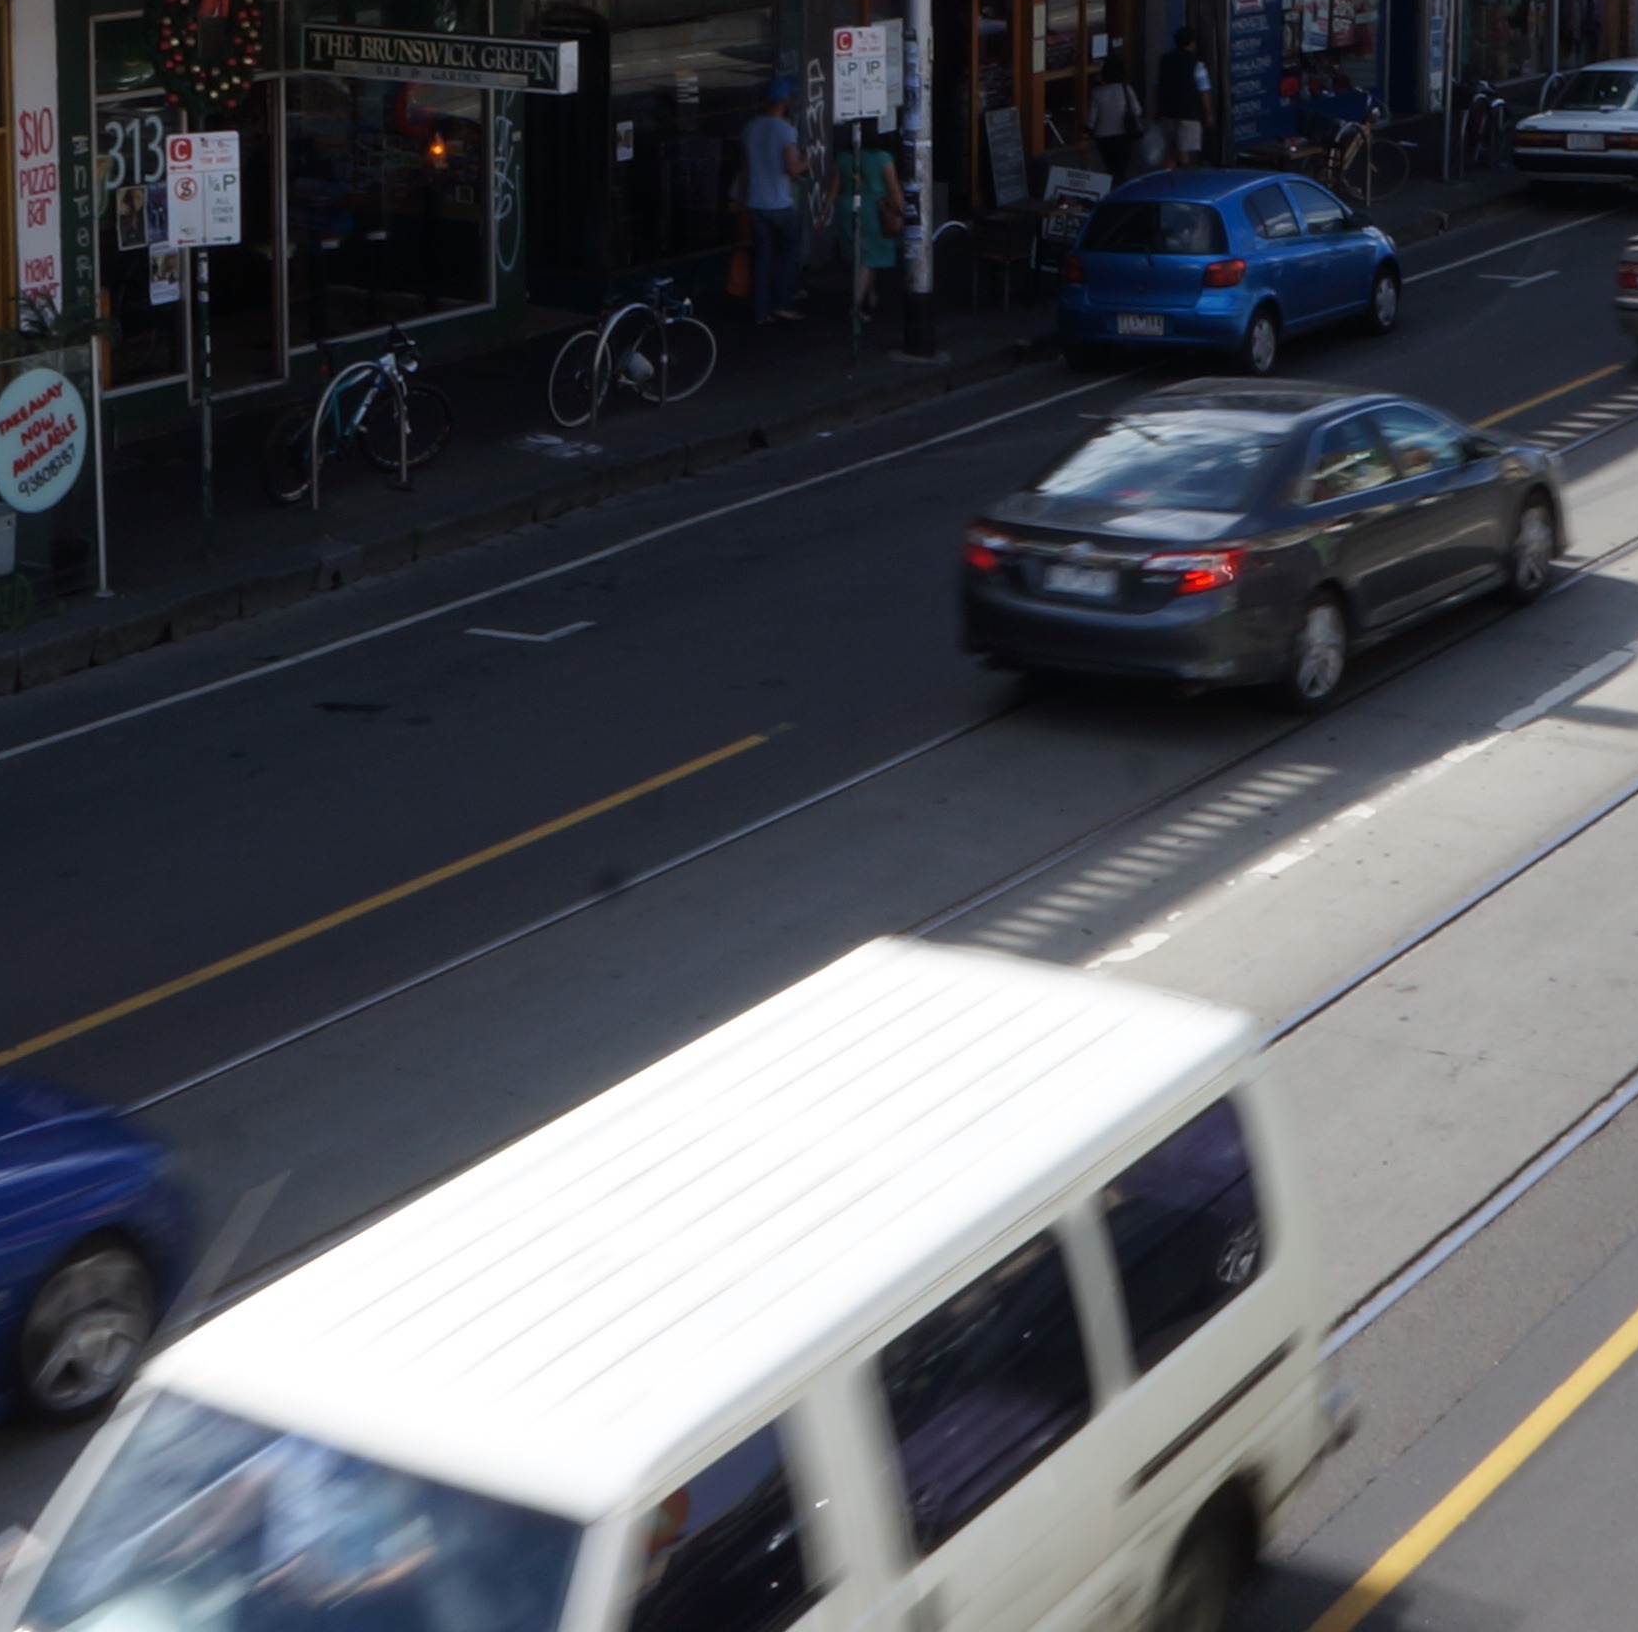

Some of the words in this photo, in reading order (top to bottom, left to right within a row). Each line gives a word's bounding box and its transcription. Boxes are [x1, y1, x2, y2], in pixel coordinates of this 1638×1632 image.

[310, 31, 356, 61] THE
[360, 34, 475, 68] BRUNSWICK
[481, 46, 555, 81] GREEN
[19, 107, 54, 160] $10
[104, 114, 164, 191] 313
[173, 139, 189, 160] C
[13, 413, 77, 477] AVAILABLE
[21, 413, 55, 445] NOW
